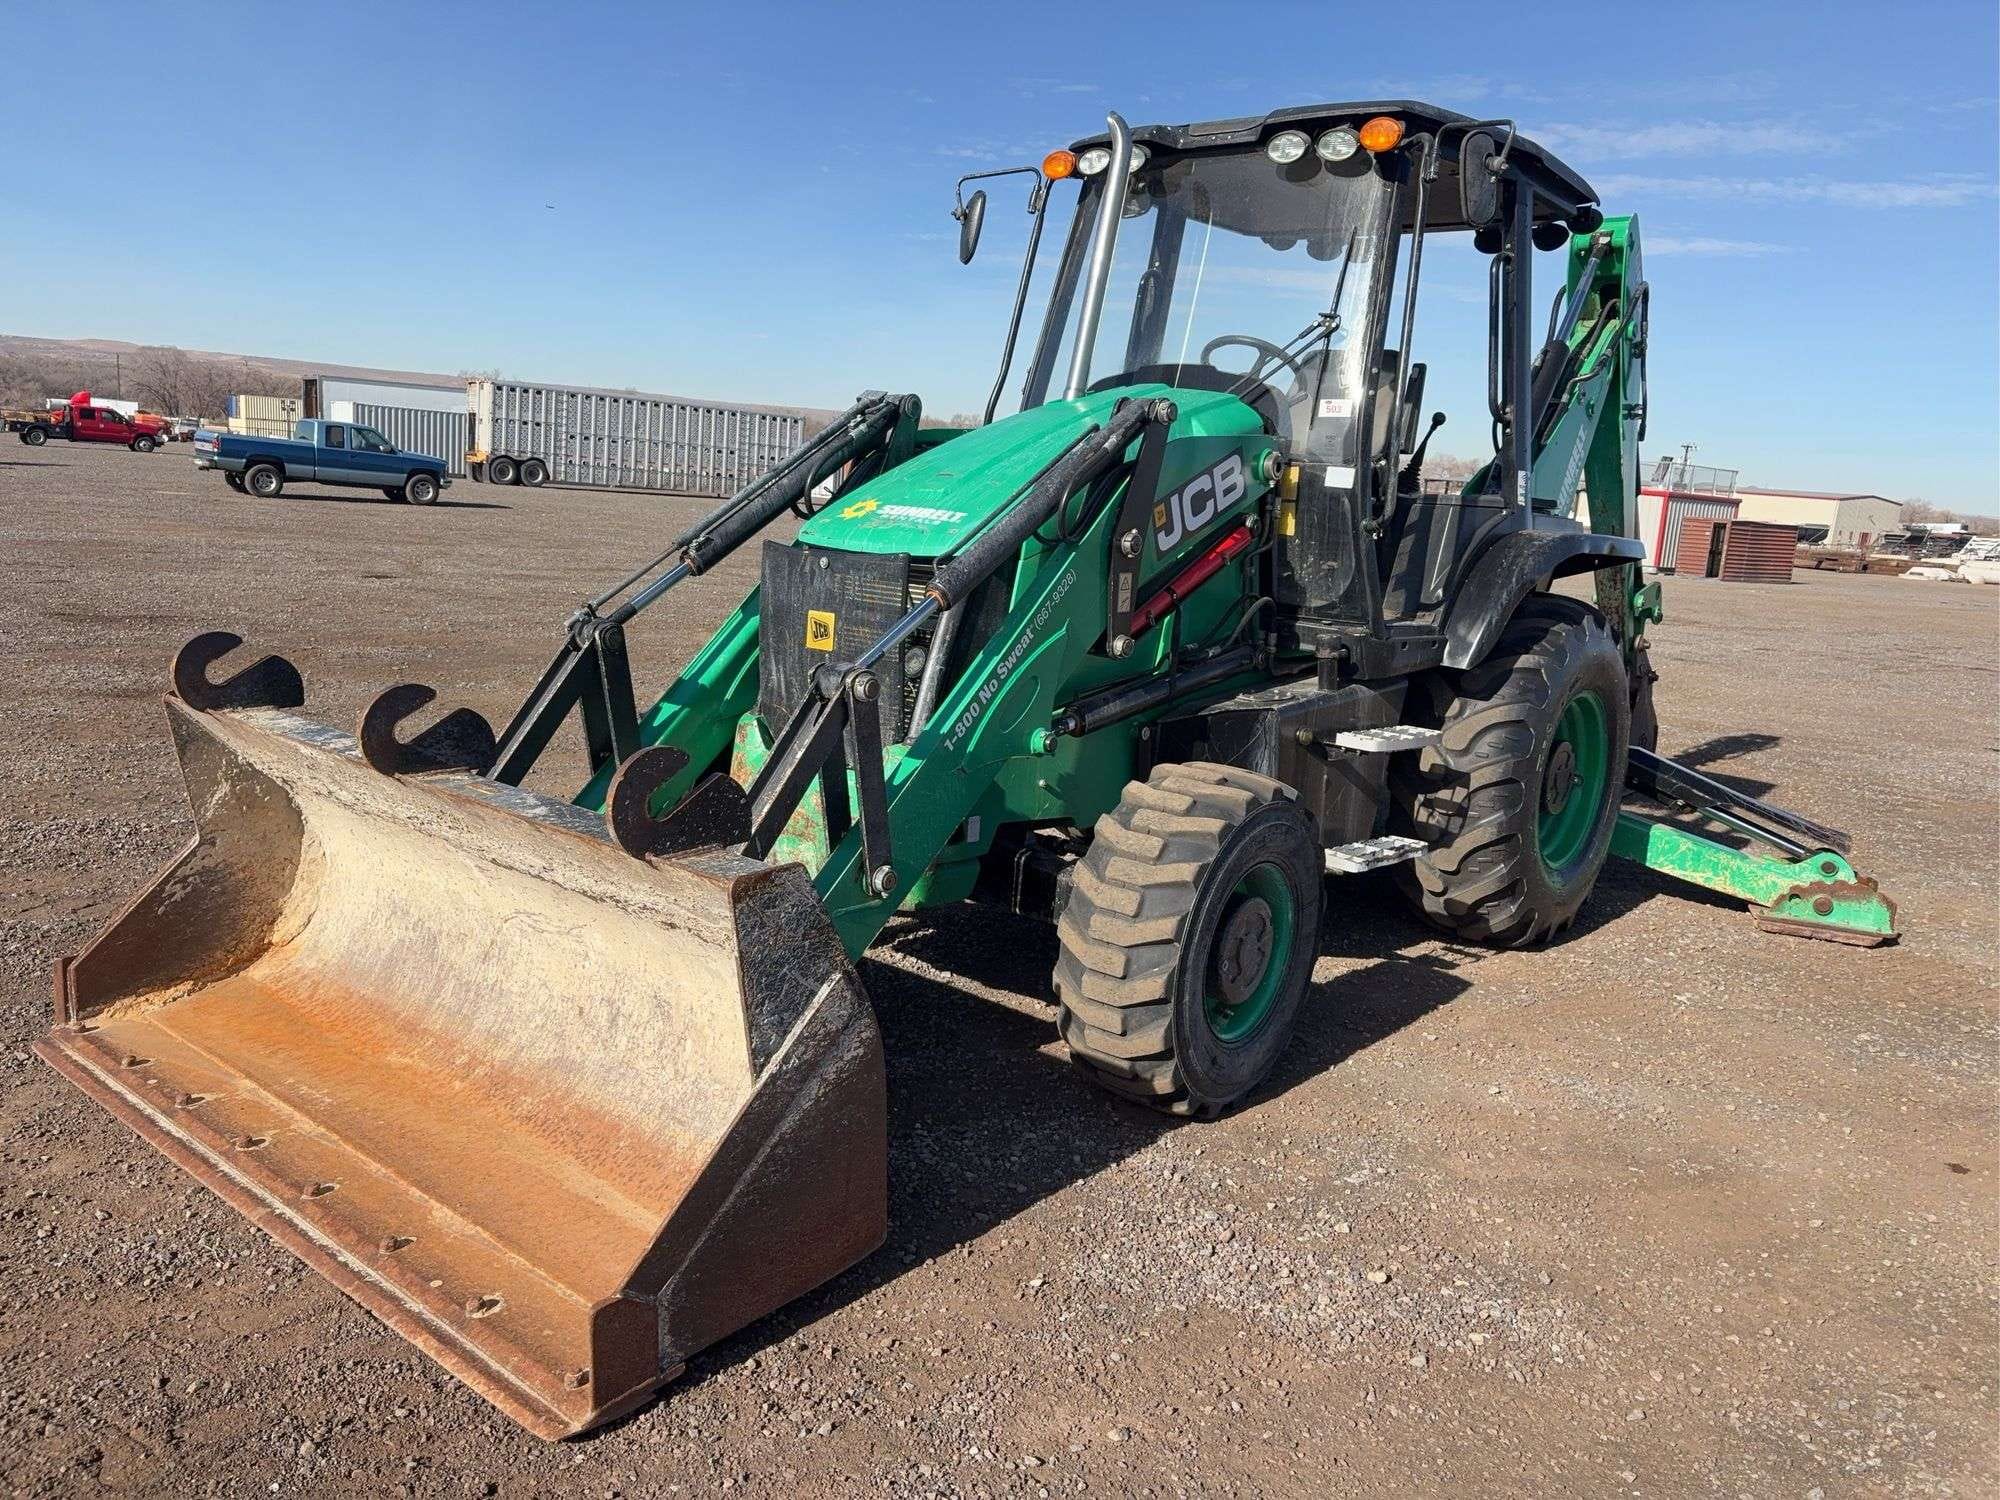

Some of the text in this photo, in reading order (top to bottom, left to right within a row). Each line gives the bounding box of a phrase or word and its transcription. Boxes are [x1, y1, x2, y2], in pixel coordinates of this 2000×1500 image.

[1157, 454, 1245, 551] JCB
[813, 620, 829, 640] JCB
[944, 568, 1077, 751] 1-800 No Sweat (667-9328)
